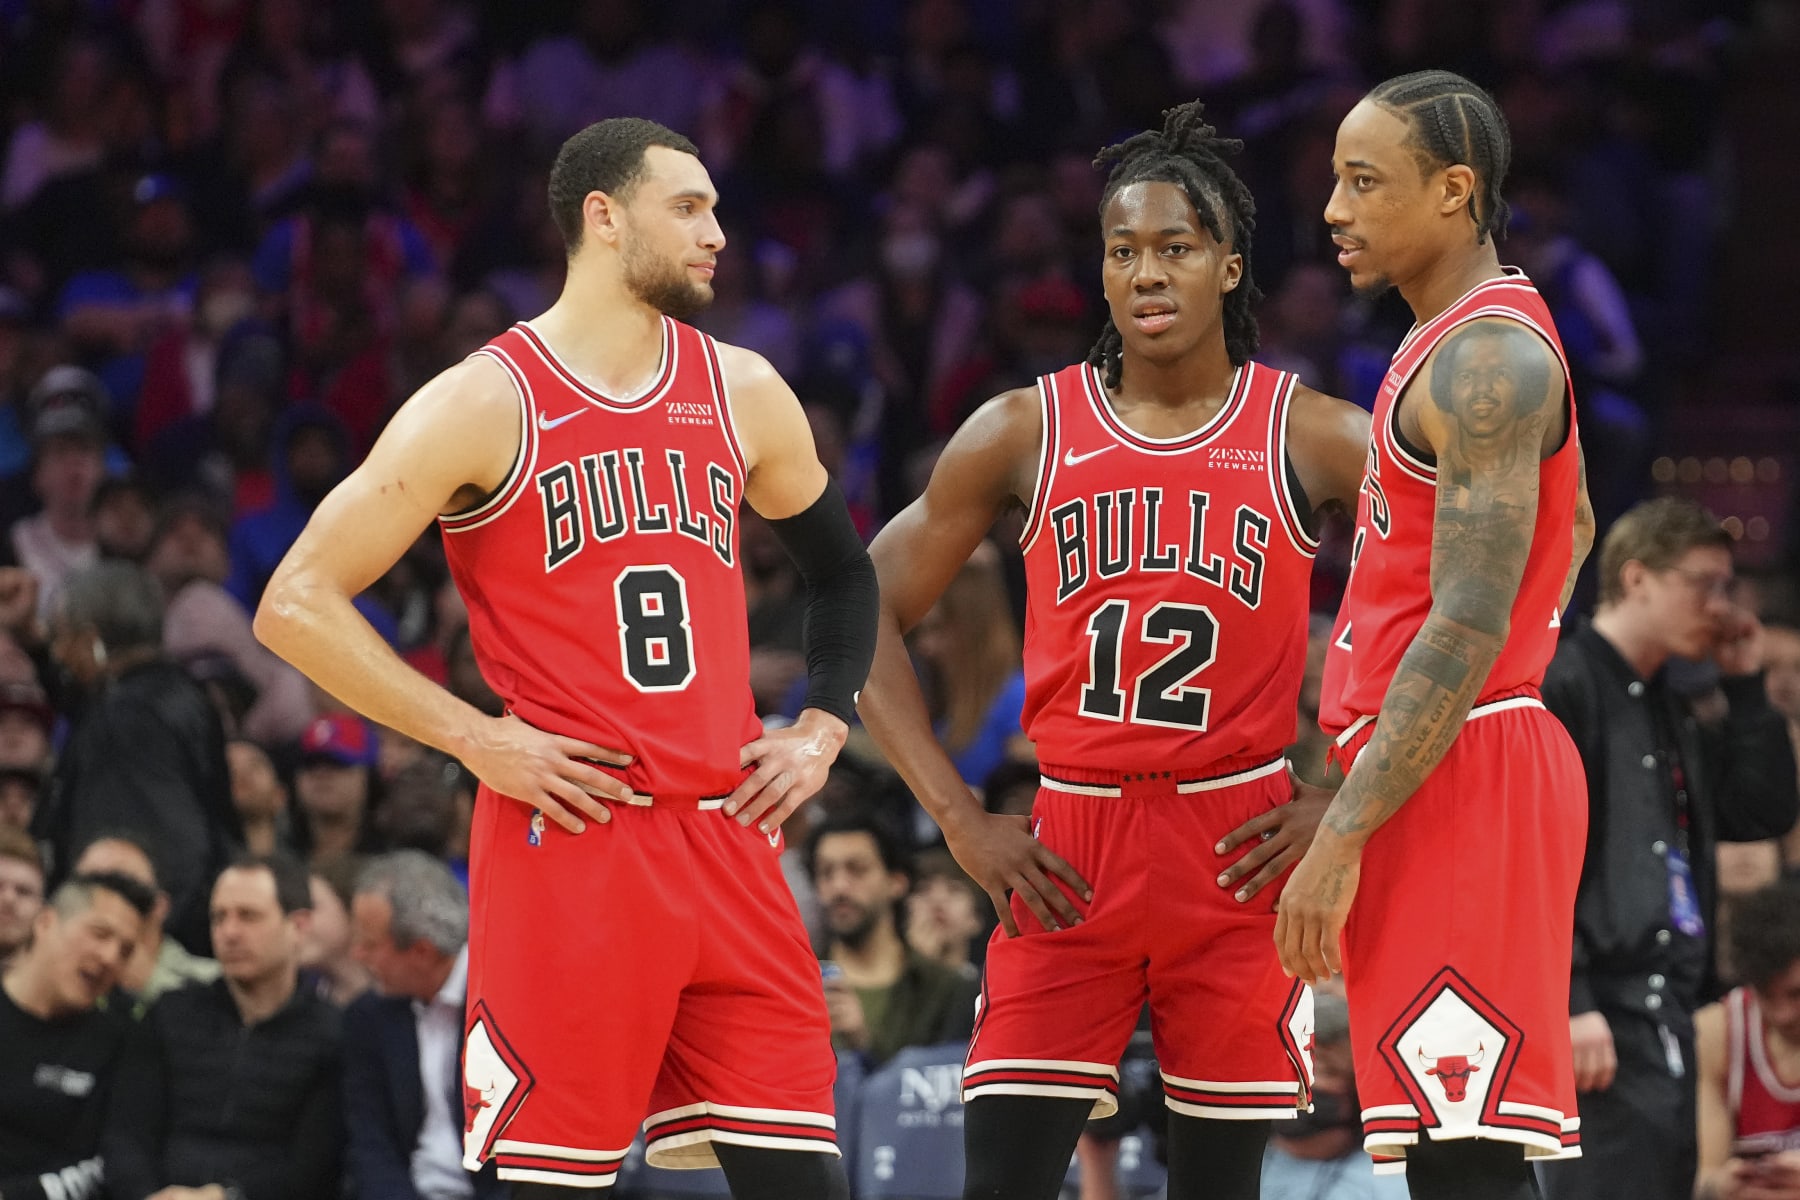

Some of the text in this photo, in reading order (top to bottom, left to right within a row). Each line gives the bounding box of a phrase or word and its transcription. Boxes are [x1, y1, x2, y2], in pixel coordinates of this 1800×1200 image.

[665, 402, 712, 415] ZENNI
[668, 416, 714, 425] EYEWEAR
[1208, 447, 1265, 463] ZENNI
[1208, 461, 1264, 472] EYEWEAR
[535, 447, 735, 574] BULLS
[1049, 486, 1271, 611] BULLS
[613, 563, 697, 693] 8
[1078, 598, 1220, 732] 12
